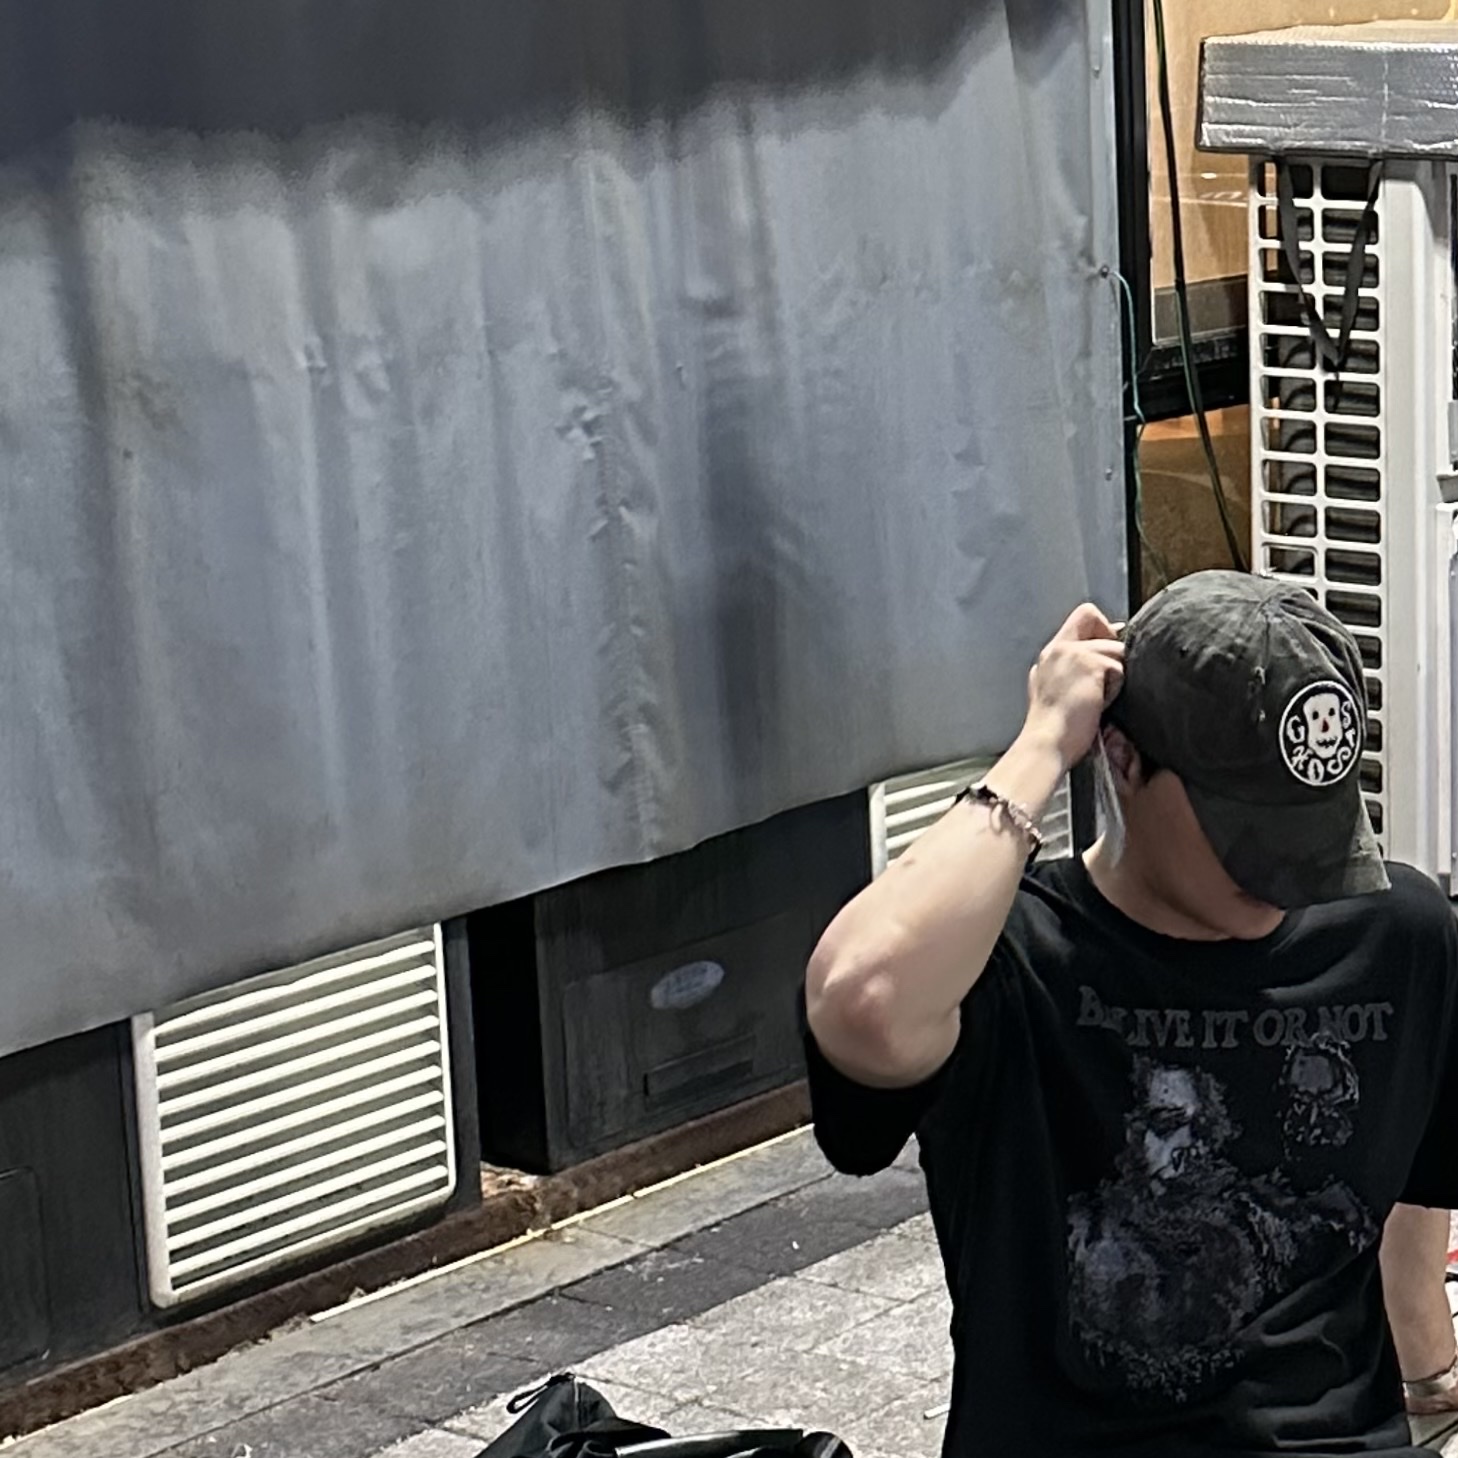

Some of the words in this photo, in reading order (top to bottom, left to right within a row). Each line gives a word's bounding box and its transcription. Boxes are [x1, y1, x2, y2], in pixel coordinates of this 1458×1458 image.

[1201, 1009, 1249, 1048] IT
[1253, 1008, 1315, 1048] OR
[1316, 1002, 1394, 1046] NOT
